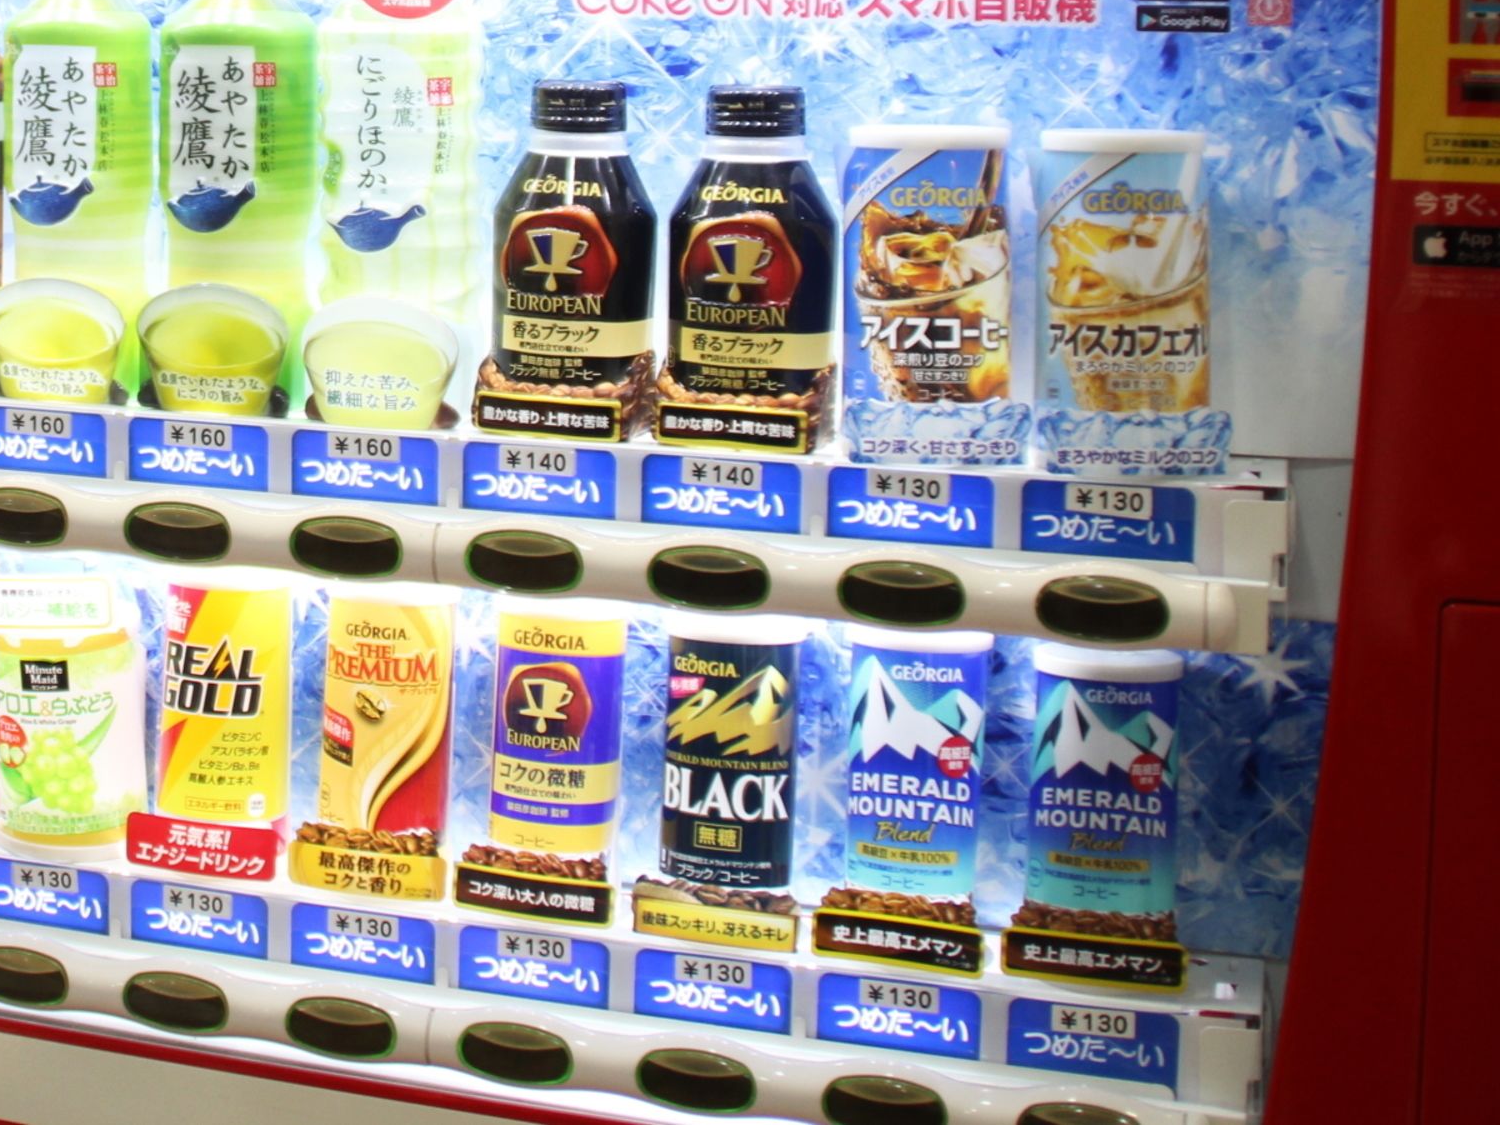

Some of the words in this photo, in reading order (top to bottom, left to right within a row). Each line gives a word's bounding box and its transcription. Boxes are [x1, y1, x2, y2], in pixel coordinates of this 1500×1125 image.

[1160, 13, 1202, 29] Google
[1204, 13, 1228, 29] Play
[15, 66, 63, 168] 綾鷹
[61, 56, 88, 178] あやたか
[174, 65, 222, 169] 綾鷹
[220, 55, 250, 180] あやたか
[357, 55, 388, 189] にごりほのか
[1458, 230, 1494, 248] App
[506, 291, 601, 315] EUROPEAN
[686, 300, 786, 327] EUROPEAN
[512, 320, 600, 344] 香るブラック
[691, 332, 784, 356] 香るブラック
[860, 315, 1009, 350] アイスコーヒー
[893, 352, 985, 367] 深煎り豆のコク
[1075, 359, 1196, 374] まろやかミルクのコク
[325, 369, 421, 393] 抑えた苦み、
[914, 369, 967, 382] 甘さすっきり
[176, 388, 244, 404] にごりの旨み
[325, 391, 419, 412] 繊細な旨み
[917, 388, 964, 400] コーヒー
[482, 405, 610, 430] 豊かな香り・上質な苦味
[664, 414, 797, 440] 豊かな香り・上質な苦味
[862, 438, 1017, 457] コク深く・甘さすっきり
[1056, 448, 1218, 467] まろやかなミルクのコク
[506, 450, 567, 472] ¥140
[691, 463, 755, 486] ¥140
[876, 476, 941, 500] ¥130
[1076, 488, 1145, 513] ¥130
[353, 642, 394, 659] THE
[513, 627, 587, 651] GEORGIA
[25, 664, 62, 675] Minute
[167, 638, 262, 681] REAL
[328, 646, 439, 684] PREMIUM
[30, 674, 57, 685] Maid
[164, 679, 262, 718] GOLD
[221, 732, 262, 743] ビタミンC
[506, 728, 581, 752] EUROPEAN
[759, 759, 789, 771] BLEND
[940, 746, 971, 762] 高級豆
[499, 761, 586, 789] コクの微糖
[852, 771, 971, 803] EMERALD
[663, 762, 789, 821] BLACK
[1041, 786, 1162, 815] EMERALD
[847, 796, 974, 829] MOUNTAIN
[1034, 809, 1167, 839] MOUNTAIN
[168, 824, 232, 851] 元気系!
[698, 825, 738, 849] 無糖
[874, 820, 937, 845] Blend
[1070, 833, 1128, 854] Blend
[135, 841, 266, 876] エナジードリンク
[318, 849, 412, 877] 最高傑作の
[324, 871, 403, 895] コクと香り
[468, 880, 596, 913] コク深い大人の微糖
[641, 910, 790, 943] 後味スッキリ、冴えるキレ
